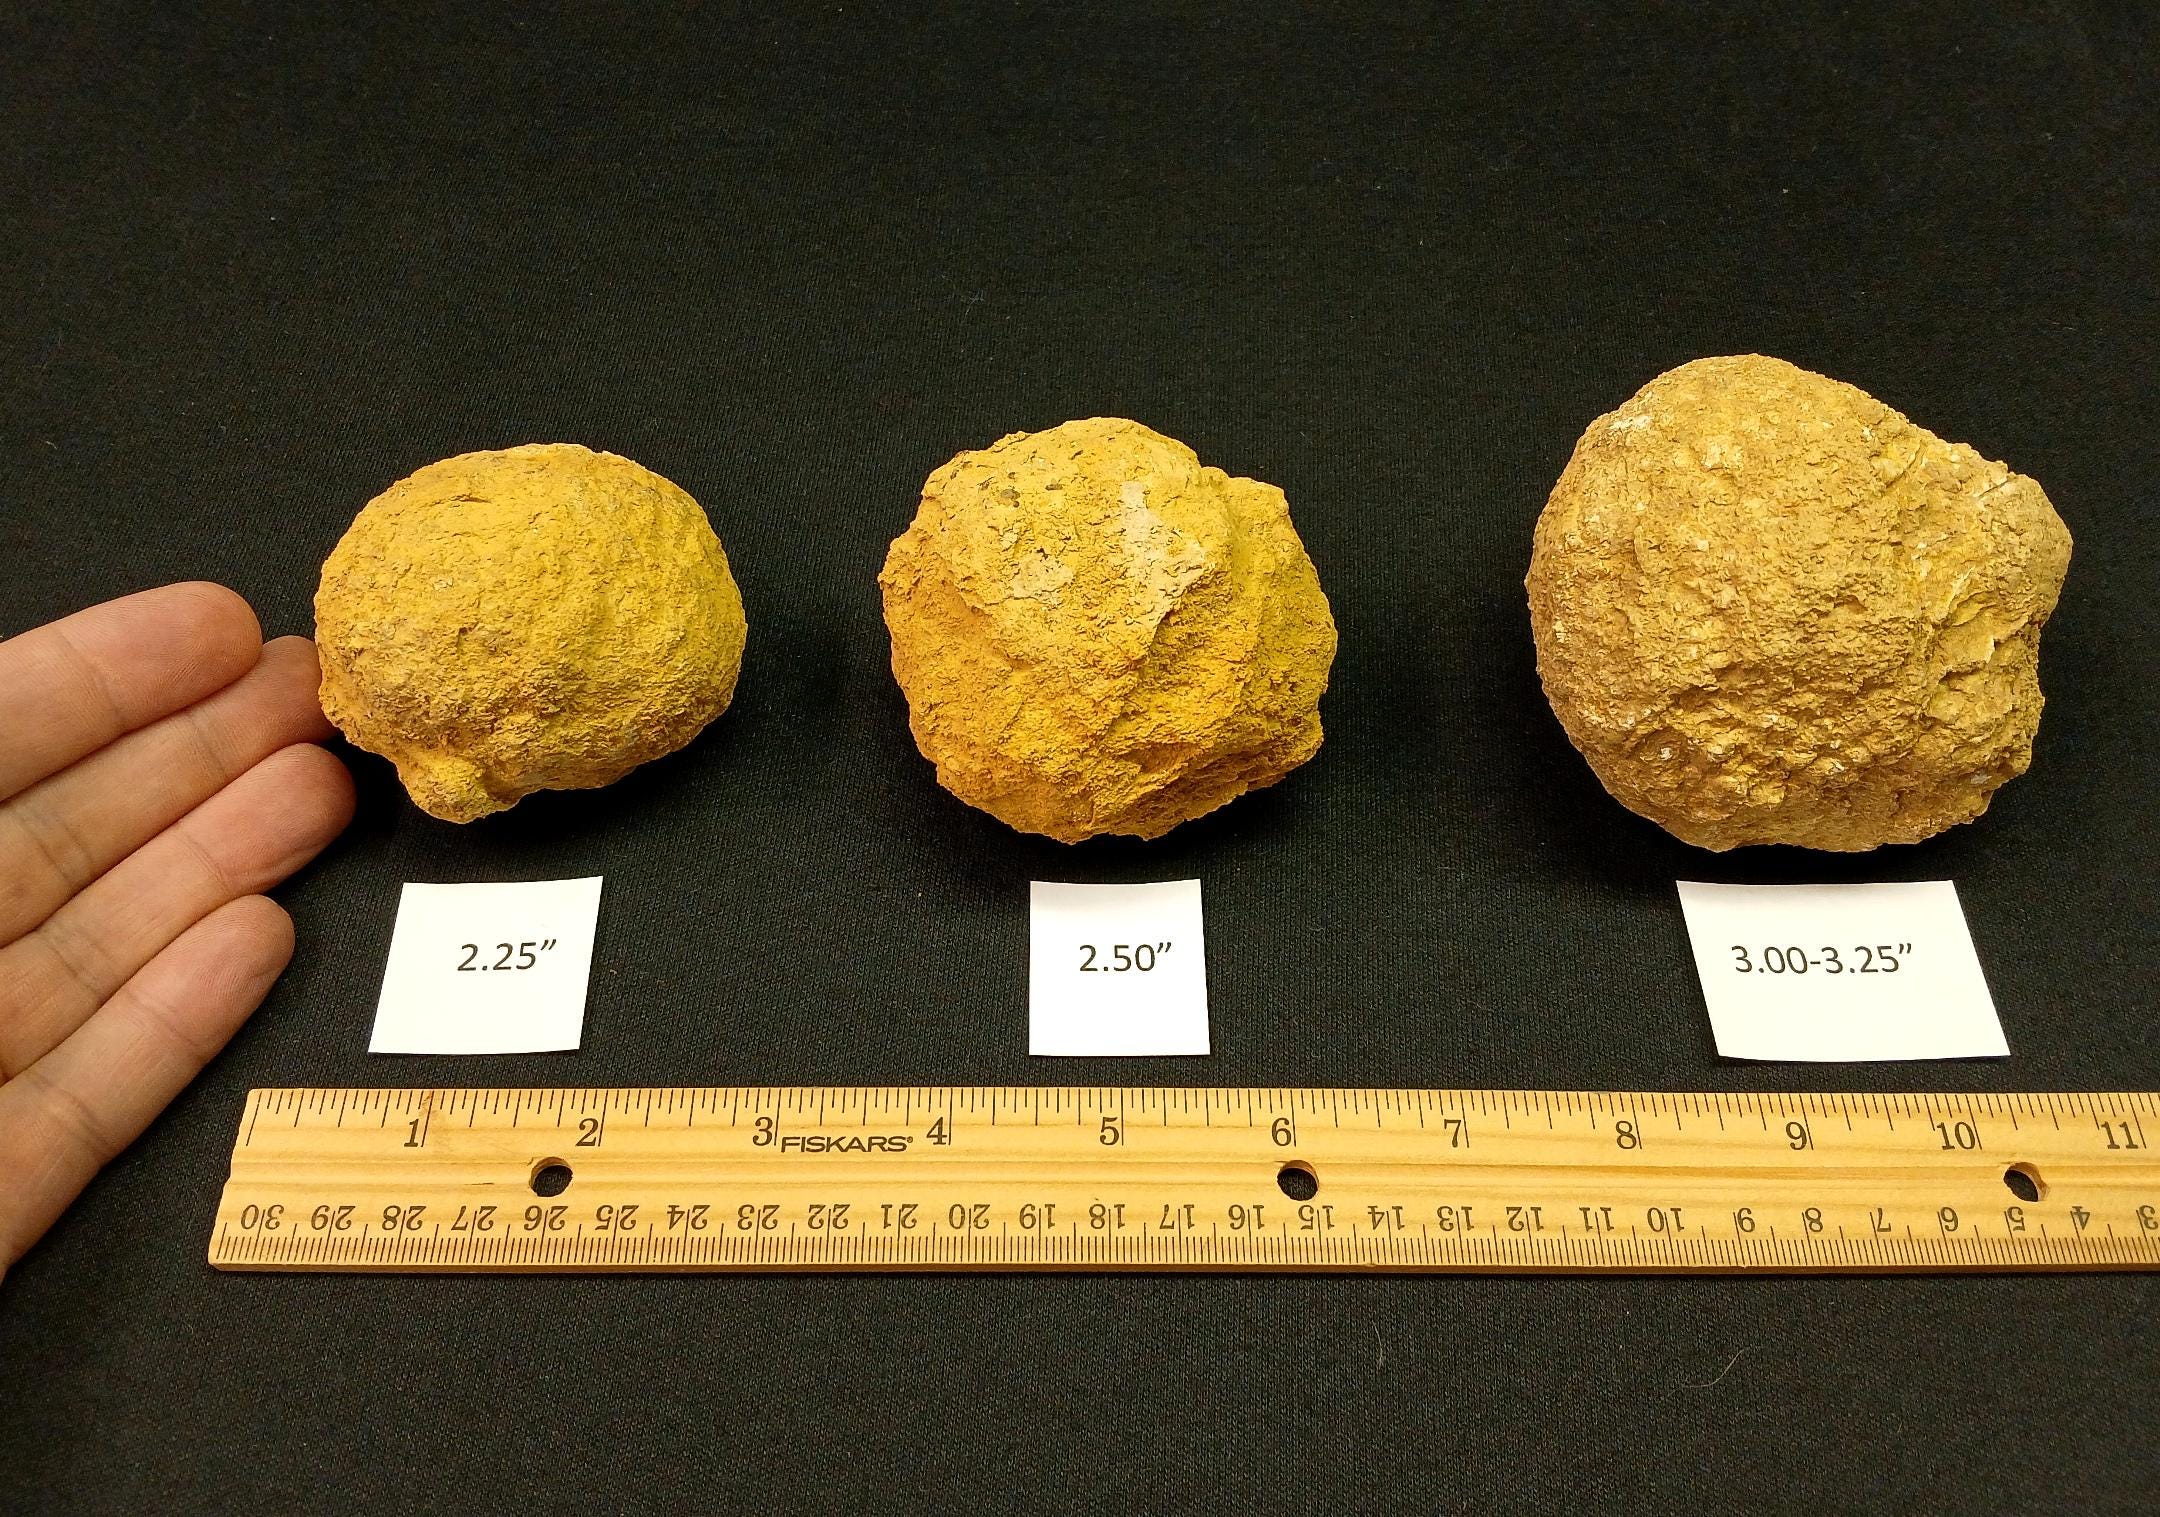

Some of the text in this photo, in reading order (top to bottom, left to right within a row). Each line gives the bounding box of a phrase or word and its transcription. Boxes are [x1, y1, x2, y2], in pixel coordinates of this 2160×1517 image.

[403, 1117, 2139, 1150] 1 2 3 4 5 6 7 8 9 10 11
[240, 1204, 2159, 1233] 3 4 5 6 7 8 9 10 11 12 13 14 15 16 17 18 19 20 21 22 23 24 25 26 27 28 29 30
